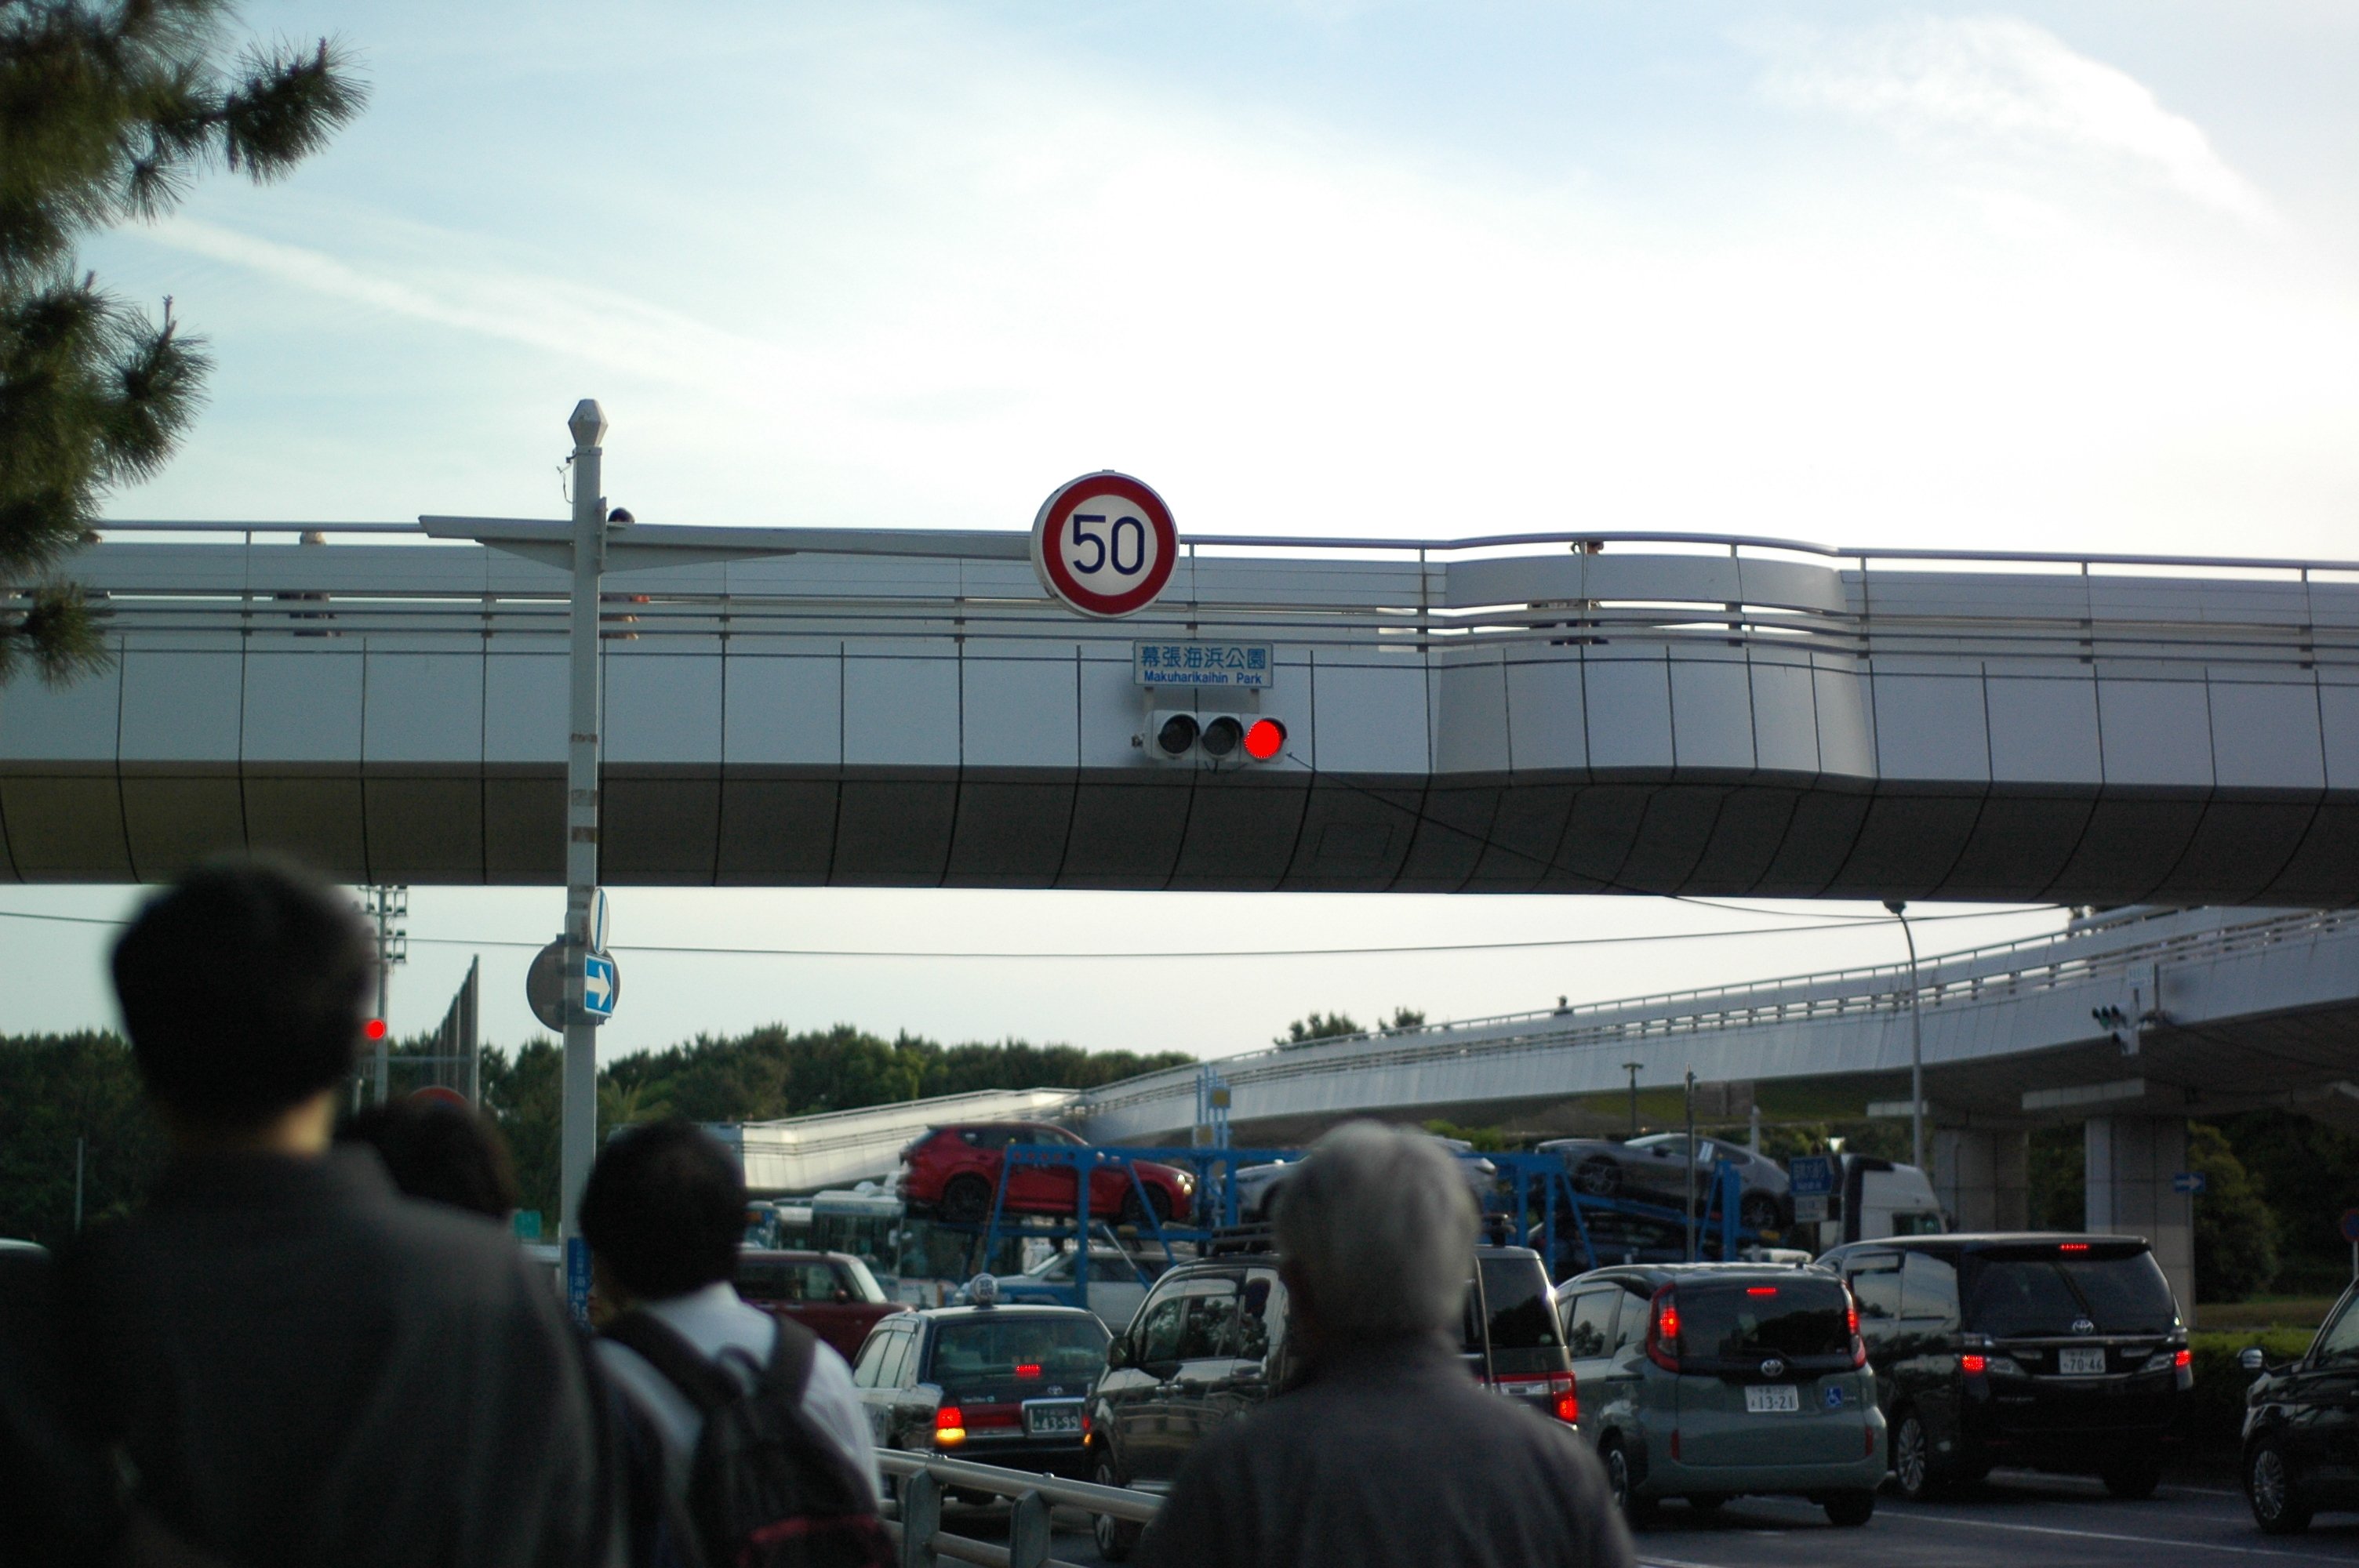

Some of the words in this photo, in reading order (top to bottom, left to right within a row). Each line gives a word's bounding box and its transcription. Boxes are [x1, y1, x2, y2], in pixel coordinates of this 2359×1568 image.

[1073, 514, 1145, 575] 50
[1141, 645, 1267, 670] 幕張海浜公園
[1144, 670, 1229, 684] Makuharikaihin
[1236, 672, 1263, 685] Park
[1760, 1396, 1794, 1410] 13-21
[1041, 1416, 1079, 1431] 43-99
